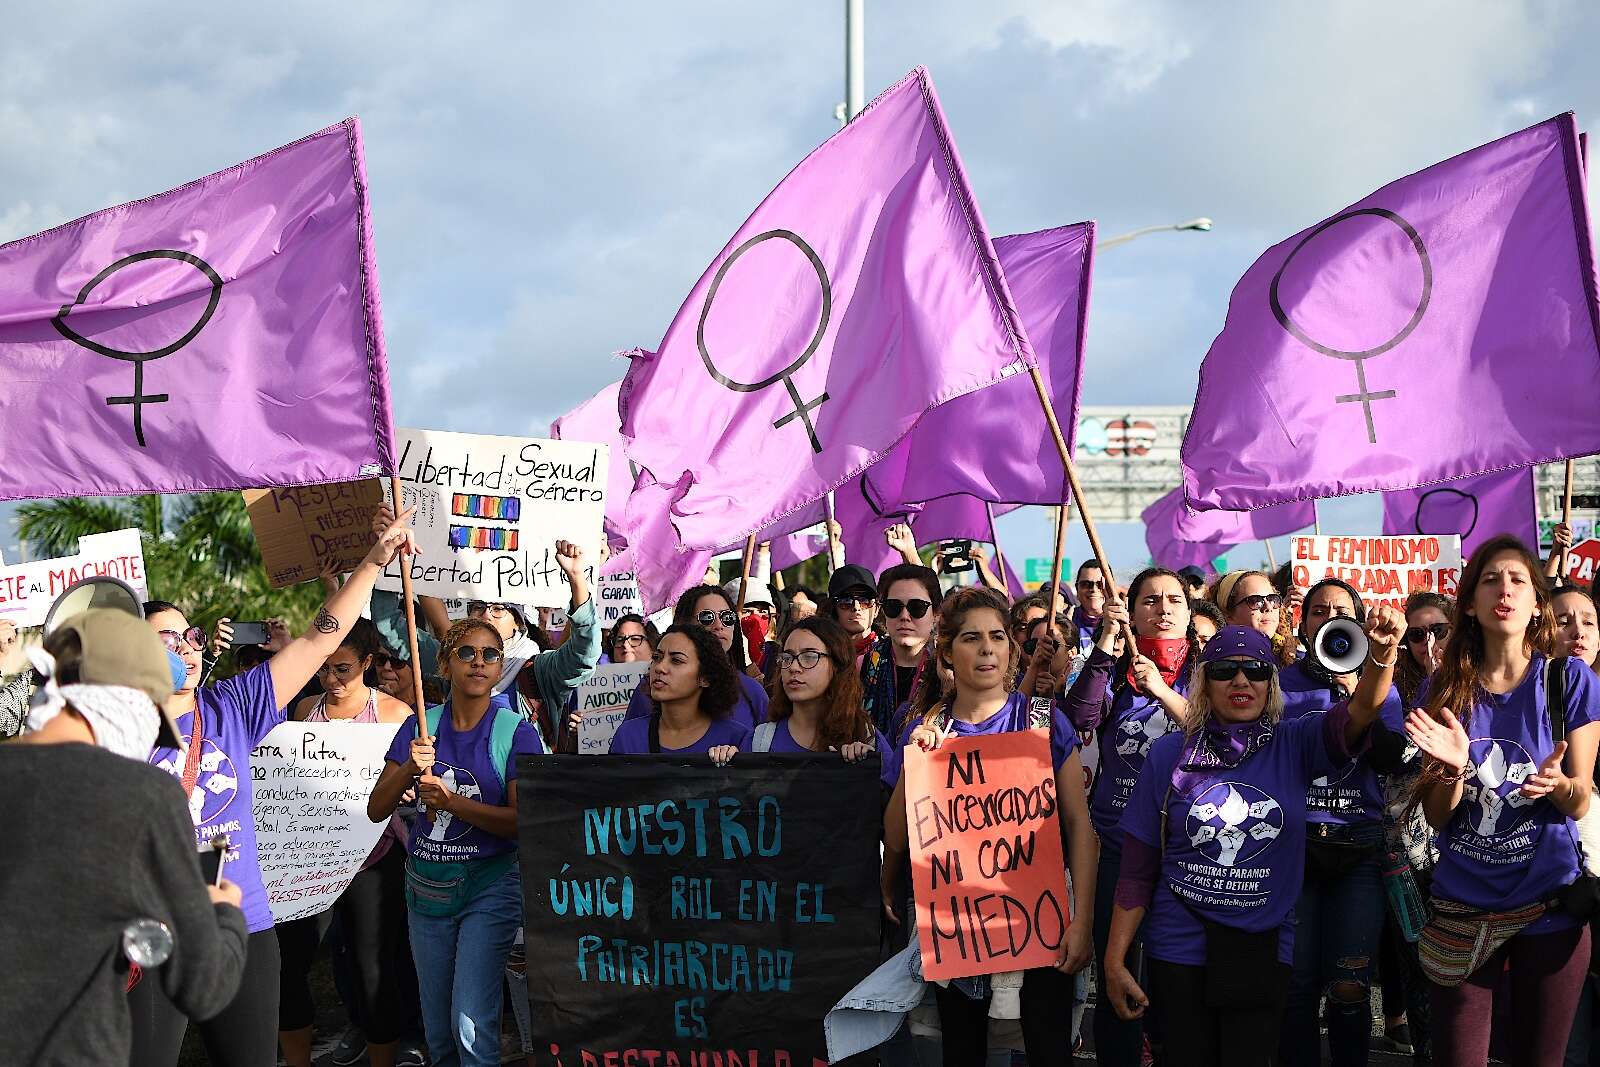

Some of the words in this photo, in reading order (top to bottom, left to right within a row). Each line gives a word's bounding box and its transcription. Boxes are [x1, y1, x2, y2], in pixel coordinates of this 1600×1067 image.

[399, 440, 505, 489] Libertad
[516, 443, 597, 483] Sexual
[526, 480, 603, 502] Género
[1328, 537, 1439, 566] FEMINISMO
[1566, 553, 1600, 580] PA
[30, 582, 45, 593] AL
[49, 556, 143, 597] MACHOTE
[384, 553, 482, 584] Lbertad
[1293, 565, 1310, 588] Q
[1407, 569, 1433, 594] NO
[1438, 568, 1458, 596] ES
[605, 606, 618, 620] NO
[613, 674, 632, 688] por
[287, 747, 297, 767] y
[302, 732, 346, 761] Puta.
[273, 766, 351, 779] merecedora
[946, 750, 986, 788] NI
[256, 784, 307, 801] conducta
[283, 836, 341, 850] educarme
[583, 795, 782, 860] NUESTRO
[931, 849, 963, 890] NI
[978, 830, 1035, 879] CON
[549, 863, 634, 921] ÚNICO
[671, 875, 722, 921] ROL
[738, 879, 778, 922] EN
[794, 881, 838, 923] EL
[1213, 880, 1224, 890] SE
[1225, 881, 1260, 891] DETIENE
[930, 889, 1064, 964] MIEDO
[577, 935, 795, 992] PATRIARCADO
[674, 996, 709, 1038] ES
